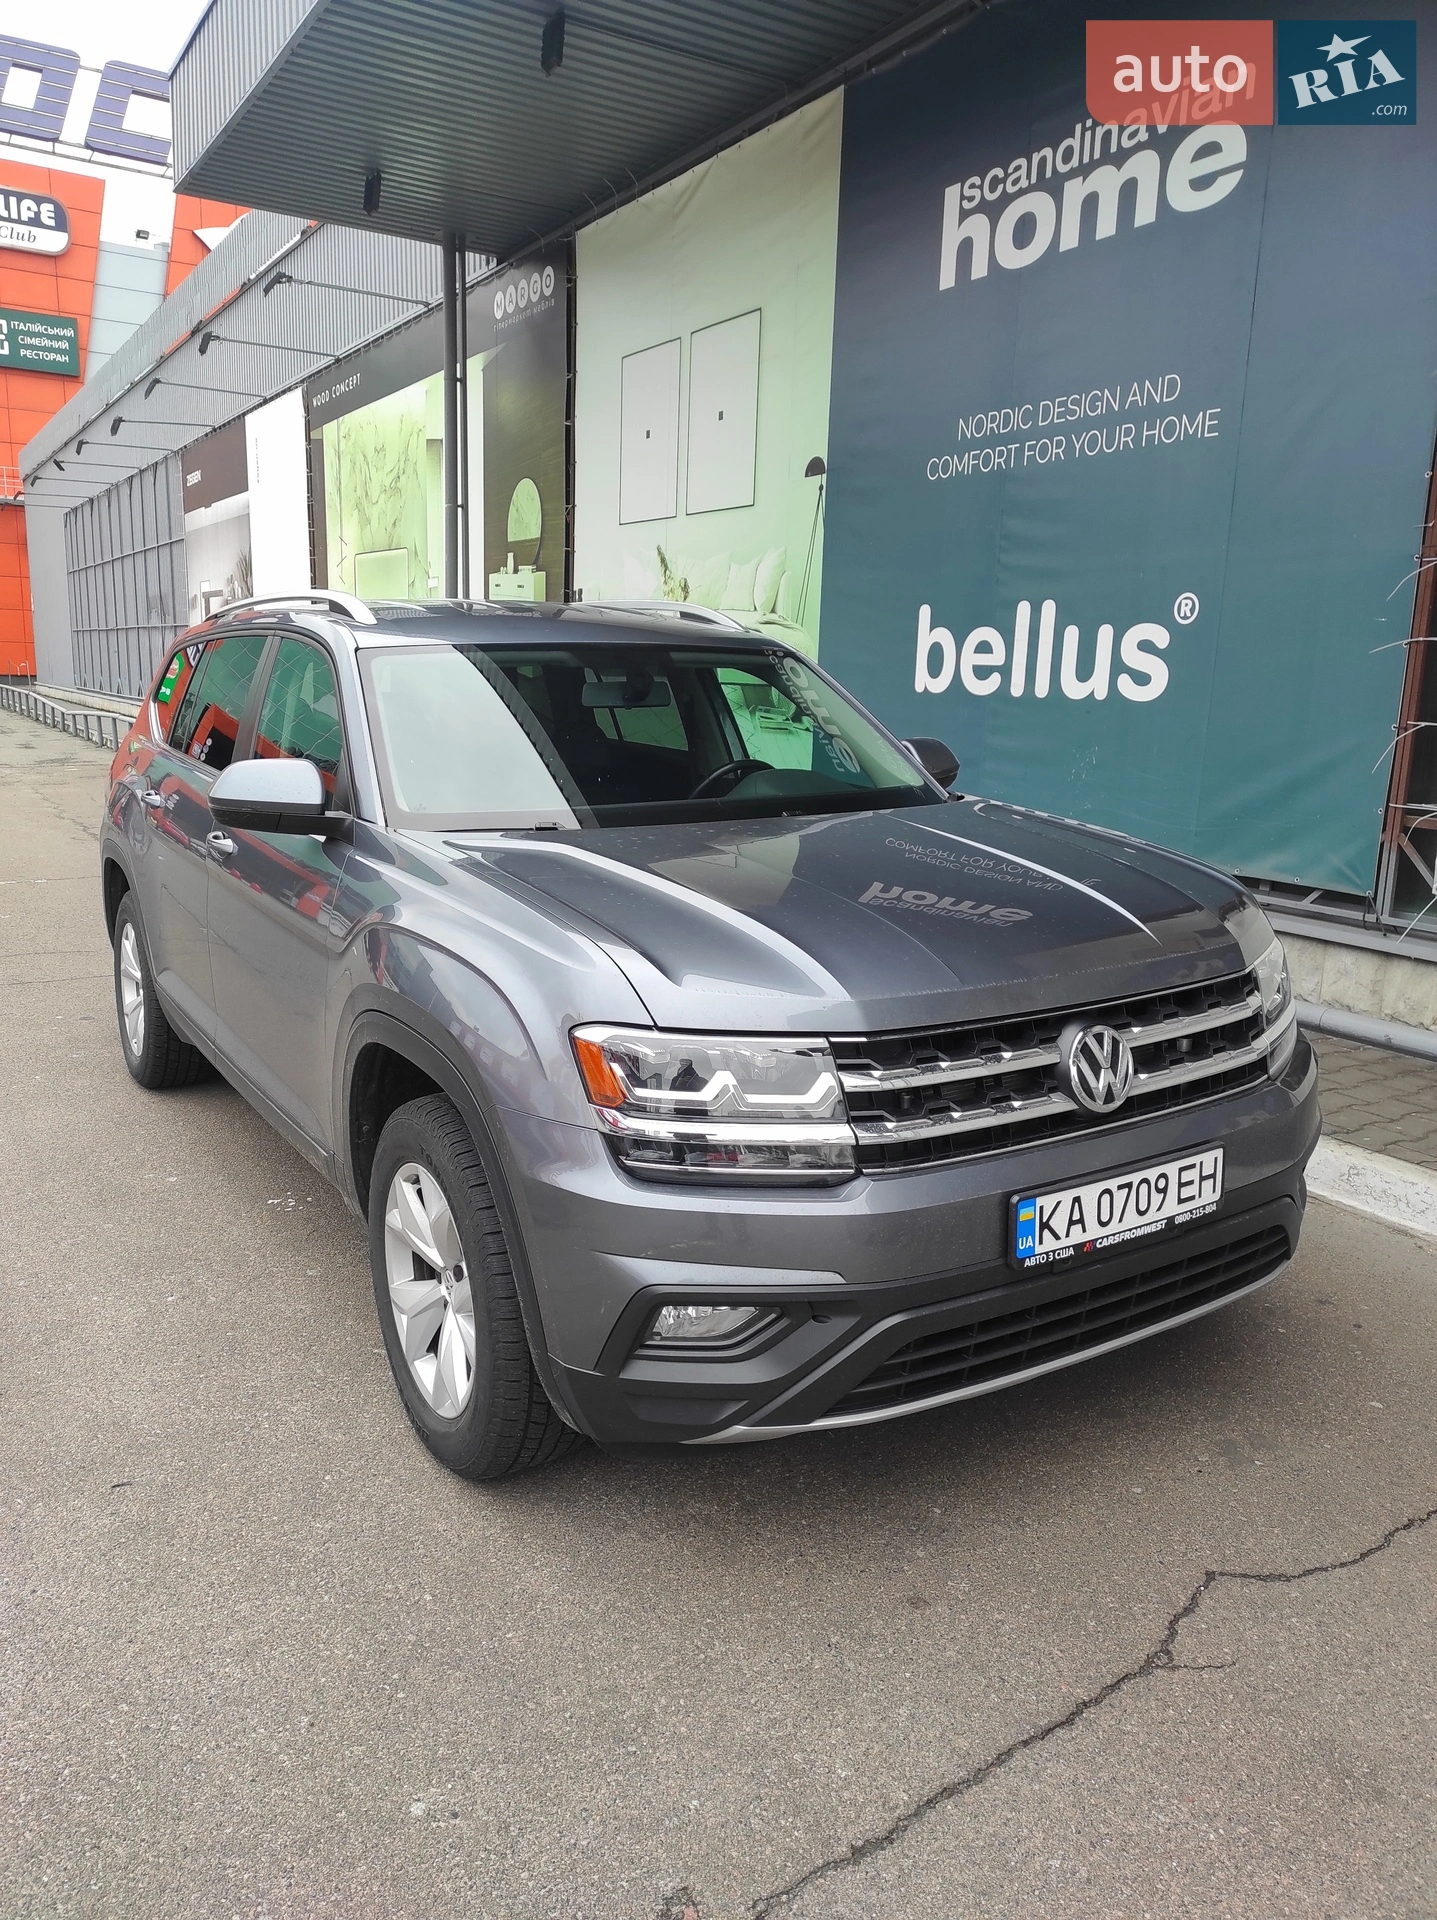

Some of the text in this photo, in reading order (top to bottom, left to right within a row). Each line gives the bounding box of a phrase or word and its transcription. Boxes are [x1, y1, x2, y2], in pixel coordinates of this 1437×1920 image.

[961, 62, 1257, 210] scandinavian
[939, 119, 1248, 291] home
[0, 225, 37, 244] Club
[494, 266, 555, 319] MARGO
[10, 320, 75, 337] ІТАЛІЙСЬКИЙ
[18, 335, 69, 350] СІМЕЙНИЙ
[20, 348, 69, 363] РЕСТОРАН
[312, 372, 361, 408] WOOD CONCEPT
[957, 374, 1181, 441] NORDIC DESIGN AND
[926, 408, 1222, 481] COMFORT FOR YOUR HOME
[1037, 1156, 1218, 1246] KA 0709 EH
[1174, 1202, 1217, 1225] 0800-215-804
[1018, 1236, 1034, 1250] UA
[1096, 1219, 1168, 1249] CARSFROMWEST
[1024, 1253, 1047, 1268] АВТО
[1054, 1247, 1075, 1260] США
